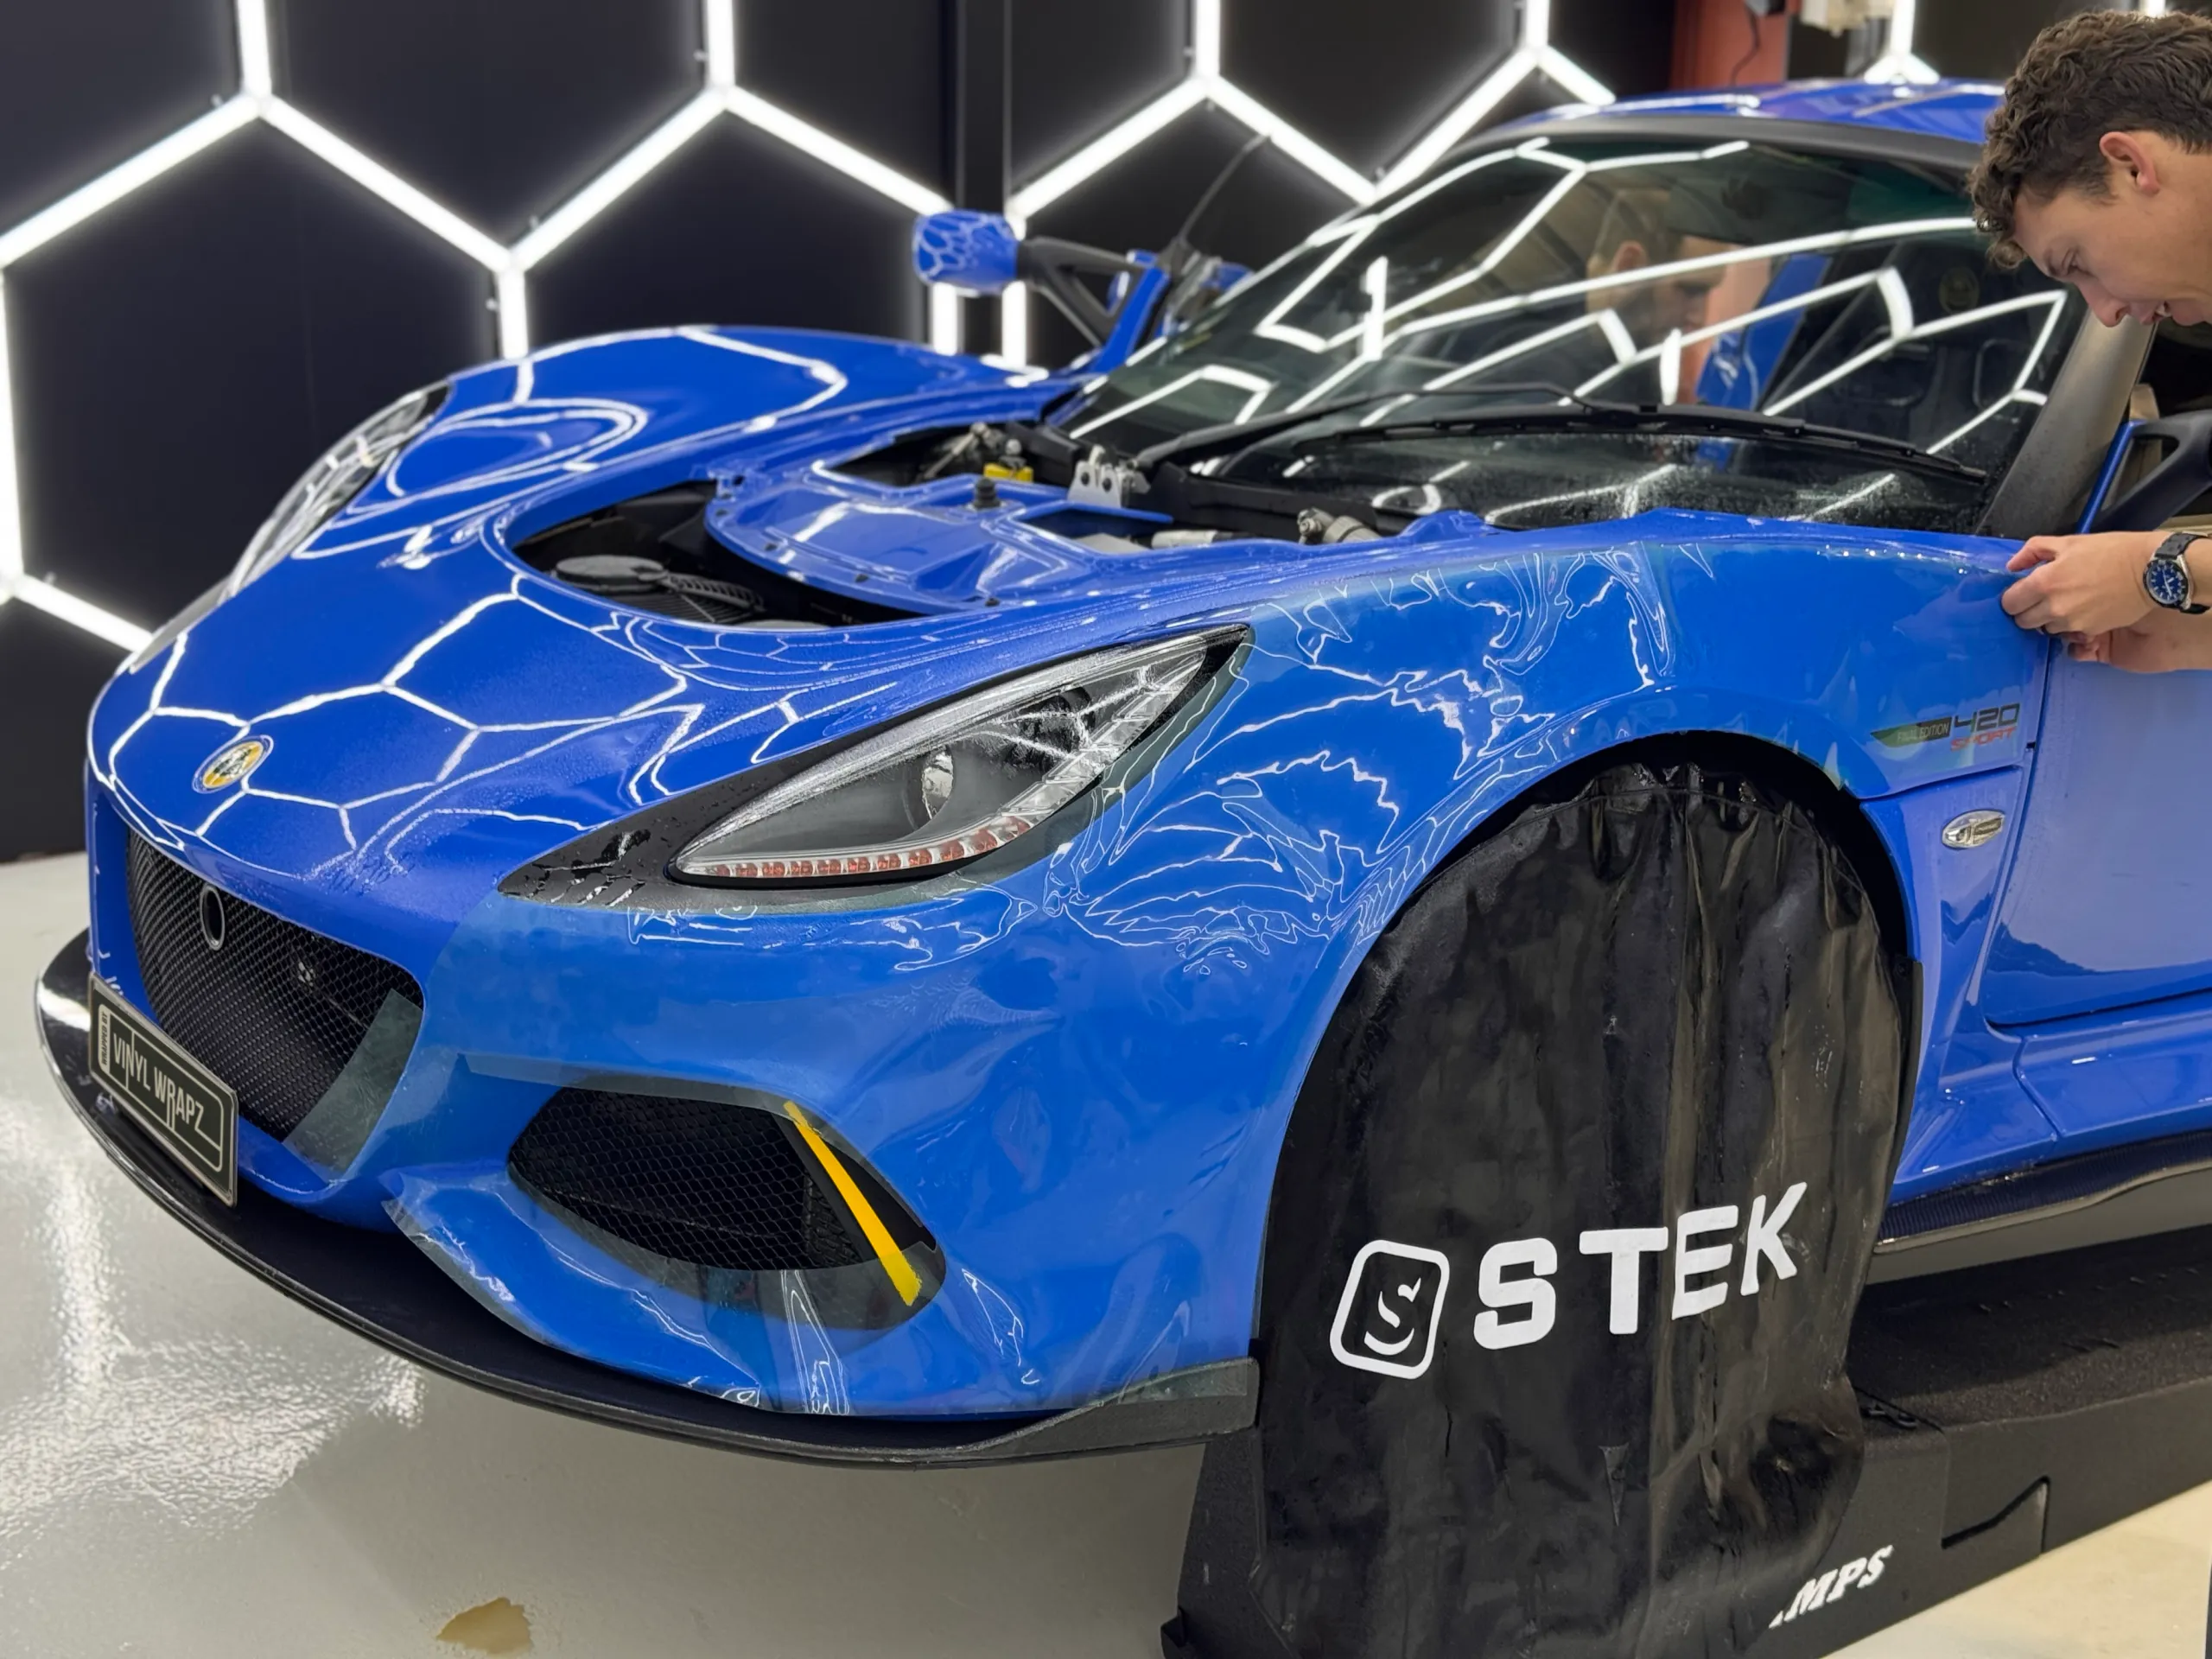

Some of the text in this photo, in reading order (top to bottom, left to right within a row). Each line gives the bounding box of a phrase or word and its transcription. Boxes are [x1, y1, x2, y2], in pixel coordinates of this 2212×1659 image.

[1920, 722, 1950, 740] EDITION
[1955, 703, 2020, 733] 420
[101, 1013, 108, 1026] BY
[113, 1033, 204, 1131] VINYL WRAPZ
[1474, 1182, 1807, 1350] STEK
